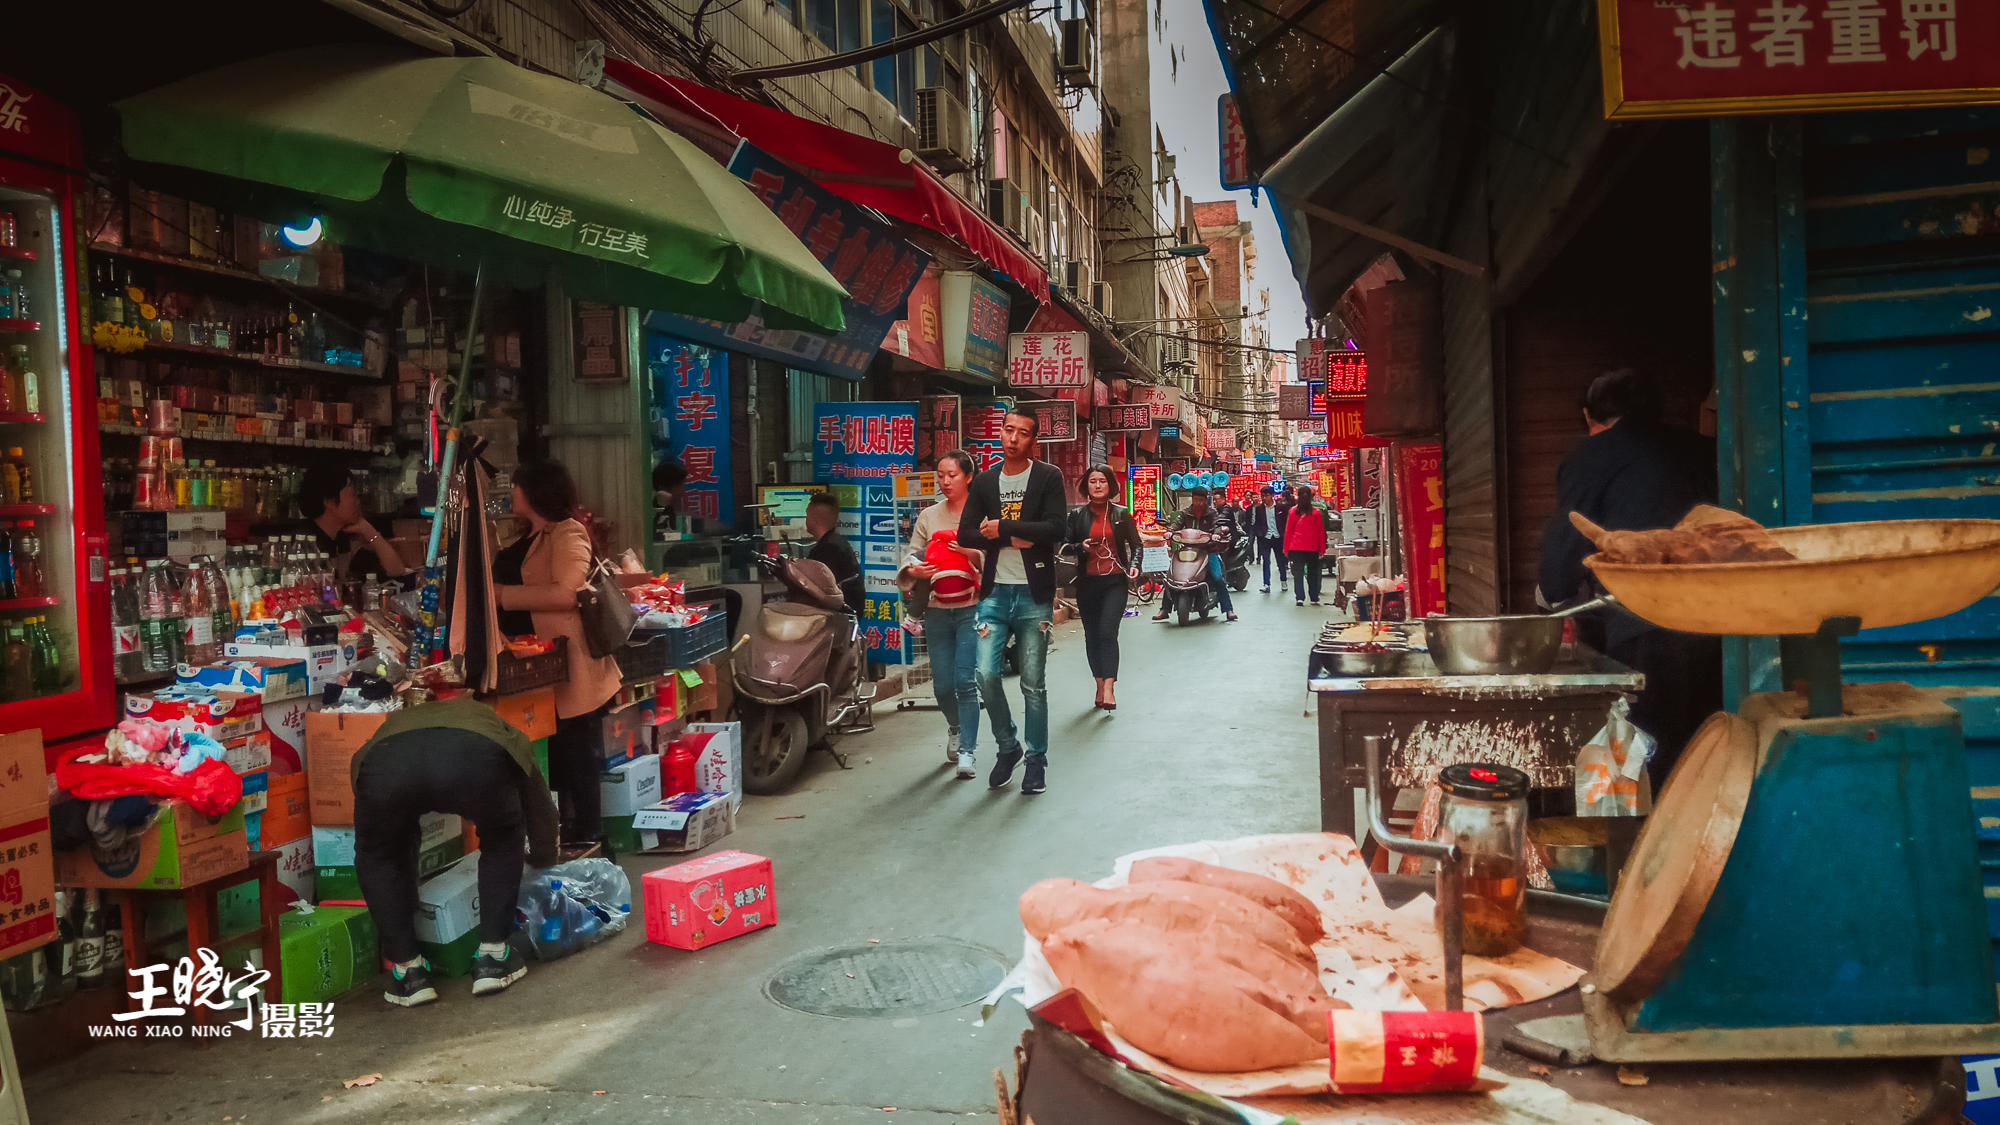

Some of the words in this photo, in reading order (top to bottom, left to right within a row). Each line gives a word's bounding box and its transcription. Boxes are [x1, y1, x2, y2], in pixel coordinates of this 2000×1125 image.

[1674, 0, 1957, 69] 违者重罚
[502, 195, 577, 229] 心纯净
[578, 222, 650, 259] 行至美
[1022, 336, 1072, 356] 莲花
[1011, 356, 1084, 384] 招待所
[1145, 389, 1167, 400] 开心
[1098, 406, 1149, 428] 美甲美睫
[1331, 410, 1364, 439] 川味
[673, 348, 719, 523] 打字复印
[817, 413, 916, 457] 手机贴膜
[1206, 438, 1235, 449] 招待所
[868, 491, 893, 502] viv
[1132, 469, 1158, 527] 手机维修
